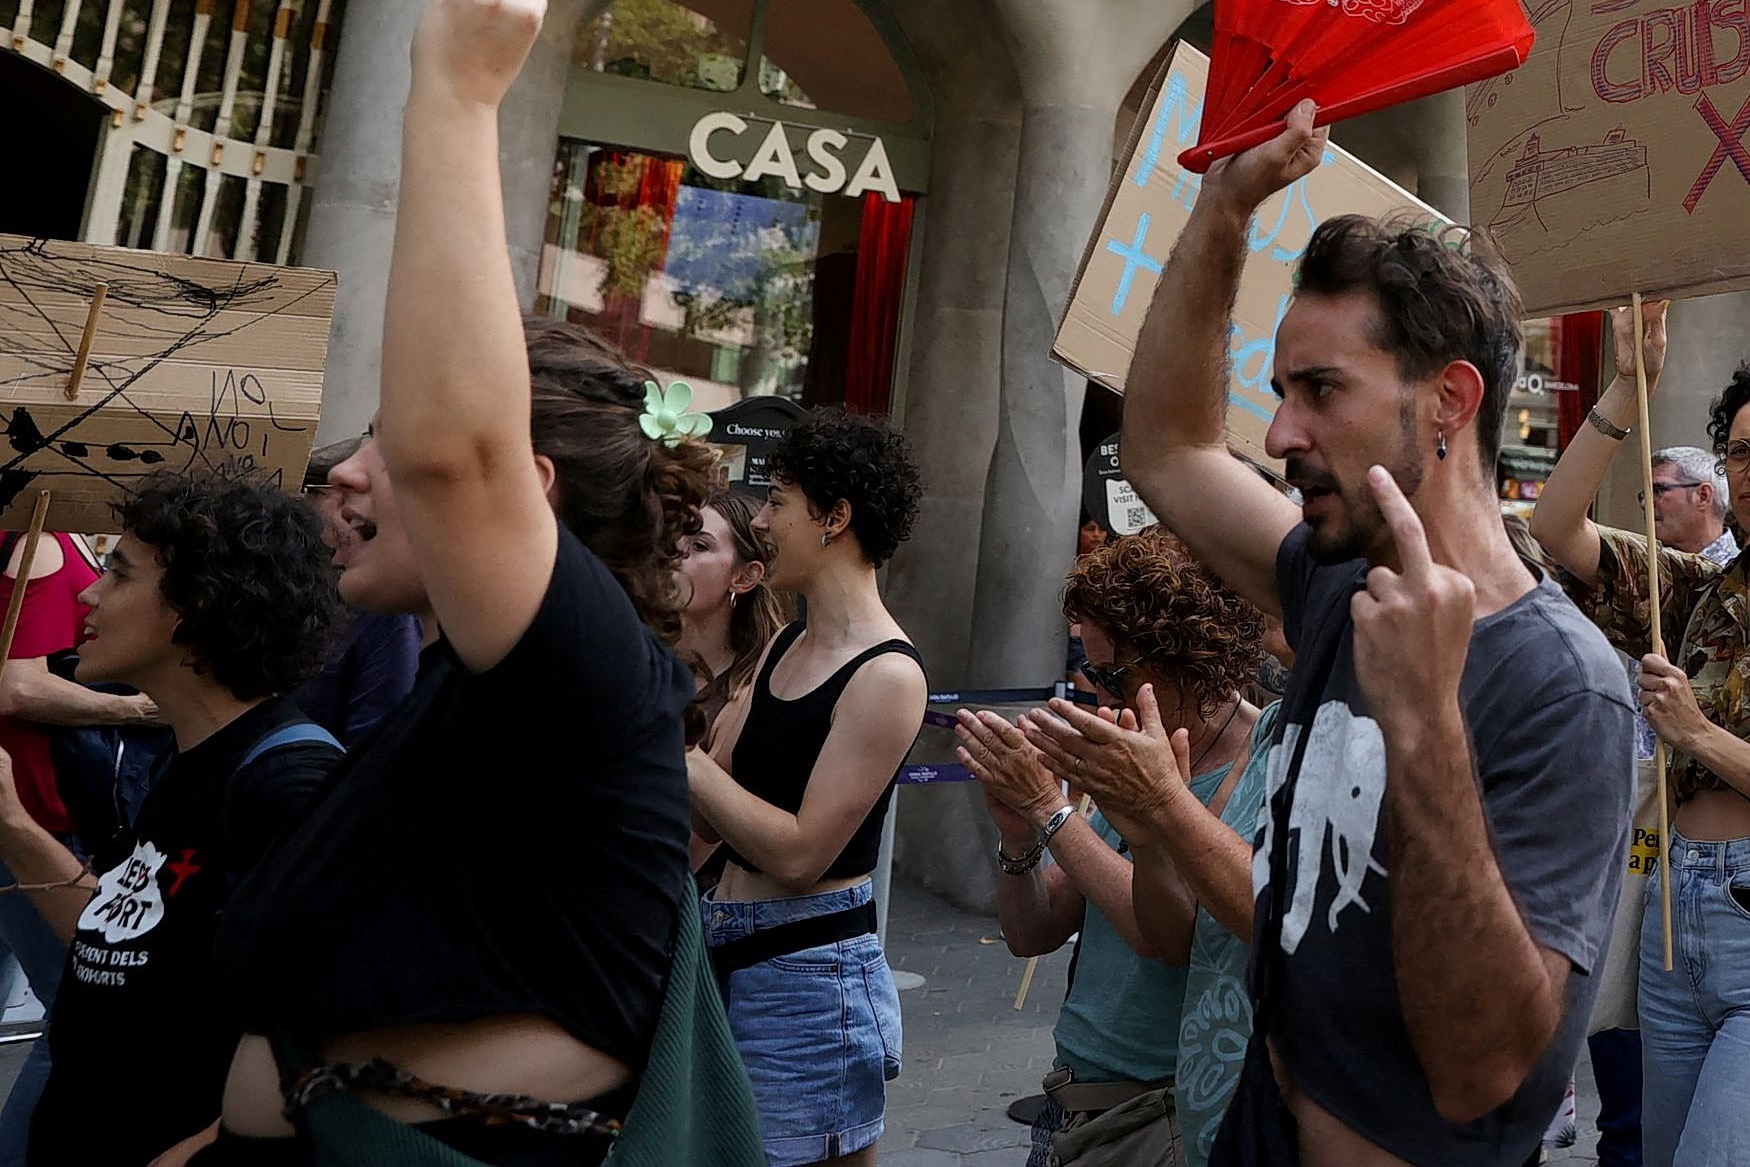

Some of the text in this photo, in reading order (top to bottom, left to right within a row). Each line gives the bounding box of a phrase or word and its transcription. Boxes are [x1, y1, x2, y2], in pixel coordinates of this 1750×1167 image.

[689, 111, 902, 204] CASA
[726, 423, 763, 437] Choose
[110, 950, 149, 967] DELS
